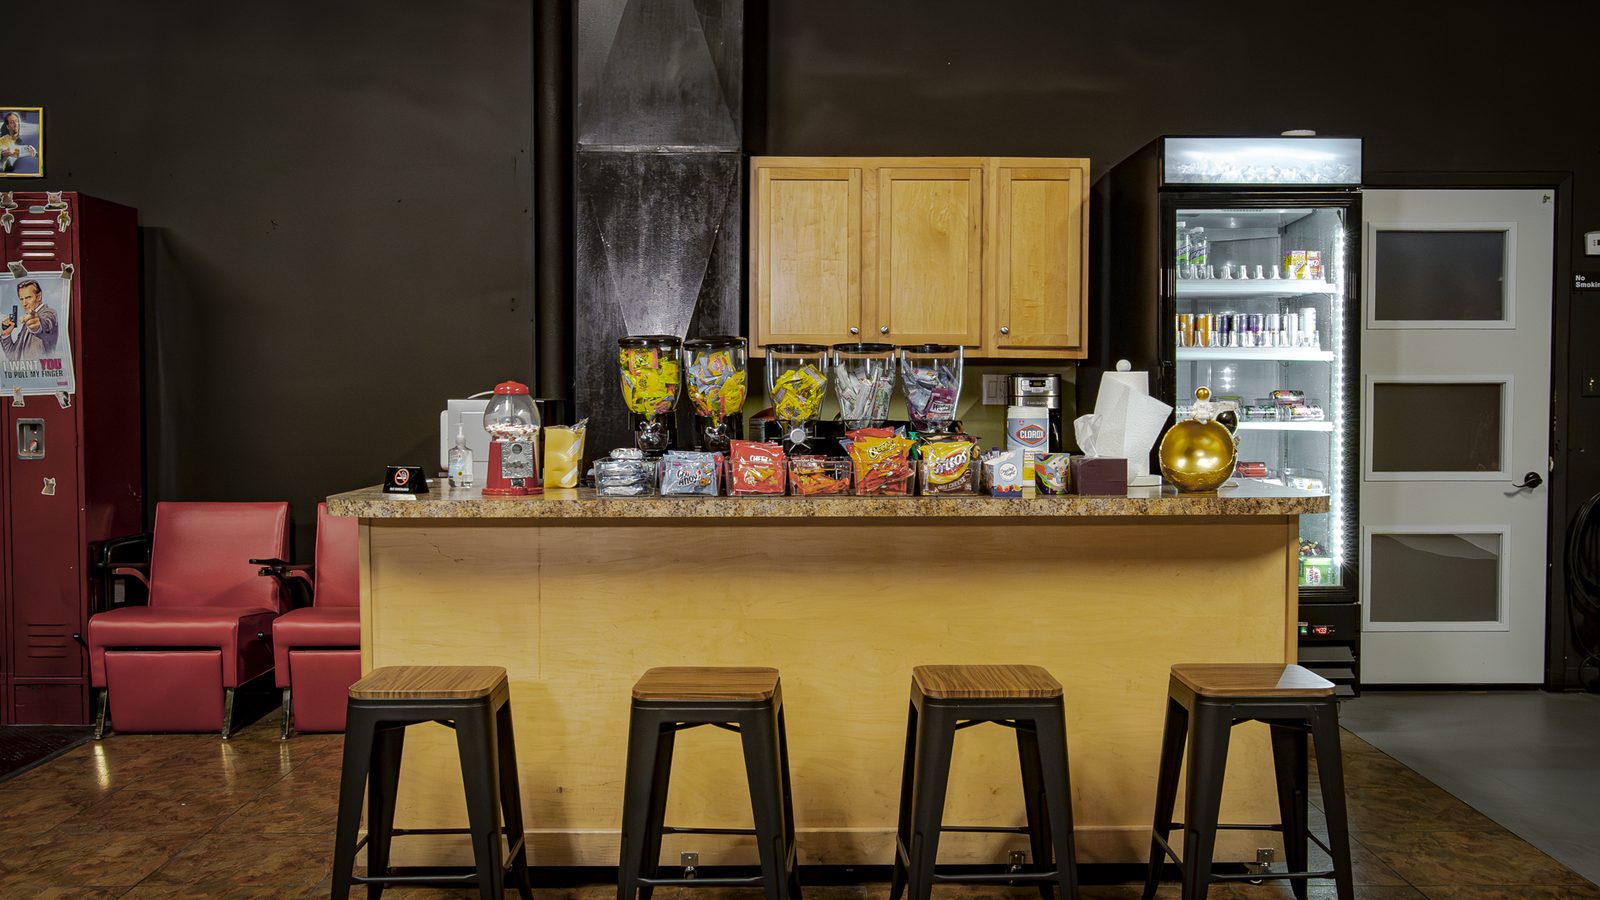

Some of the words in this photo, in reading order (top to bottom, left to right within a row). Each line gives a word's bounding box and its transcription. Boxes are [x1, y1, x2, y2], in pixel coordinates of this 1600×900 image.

[10, 360, 39, 371] WANT
[40, 358, 62, 370] YOU
[5, 371, 12, 379] TO
[14, 371, 28, 379] PULL
[41, 370, 64, 378] FINGER
[1019, 430, 1046, 439] CLOROX
